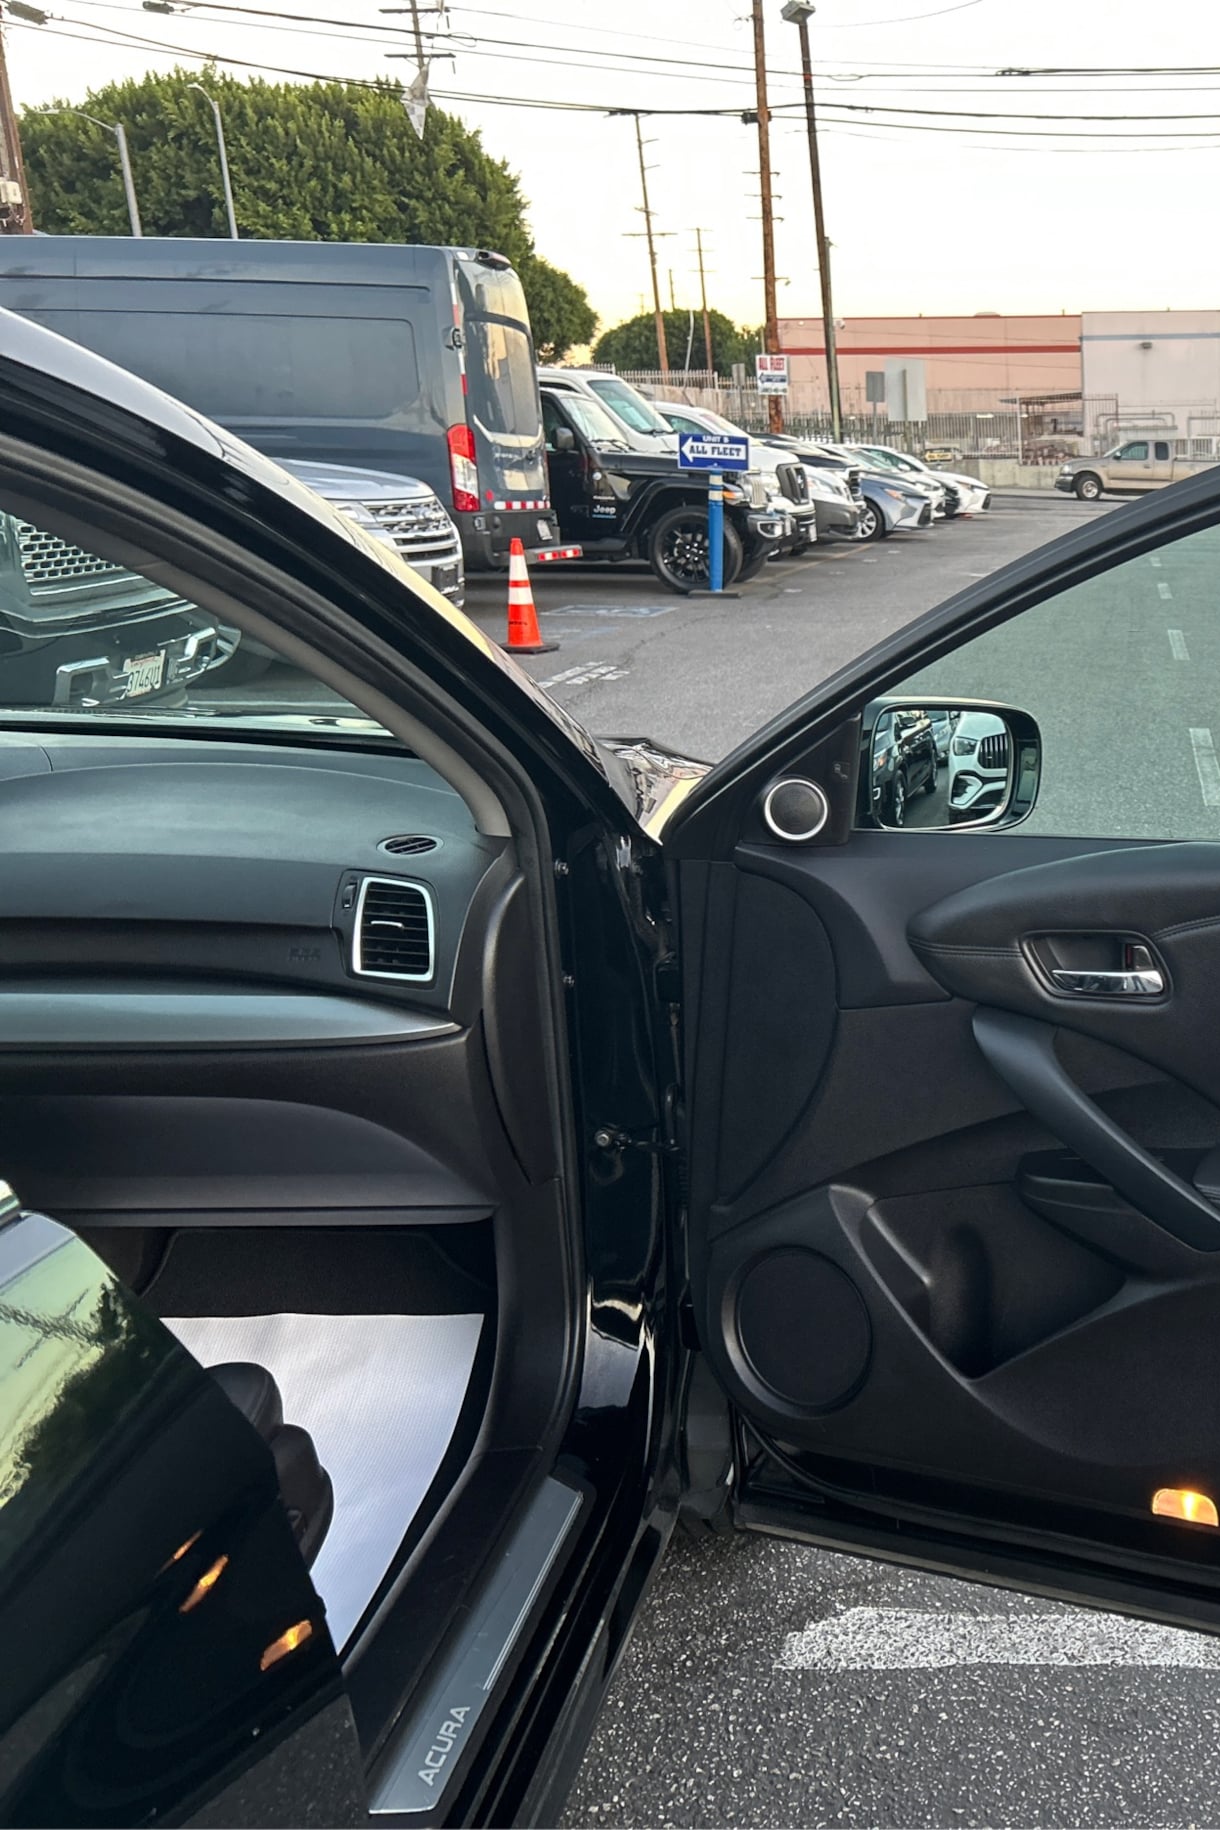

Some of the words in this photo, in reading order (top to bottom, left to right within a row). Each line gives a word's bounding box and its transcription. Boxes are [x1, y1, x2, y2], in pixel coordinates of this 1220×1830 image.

[689, 445, 707, 454] ALL
[711, 446, 742, 456] FLEET
[593, 505, 616, 514] Jeep
[418, 1706, 471, 1786] ACURA
